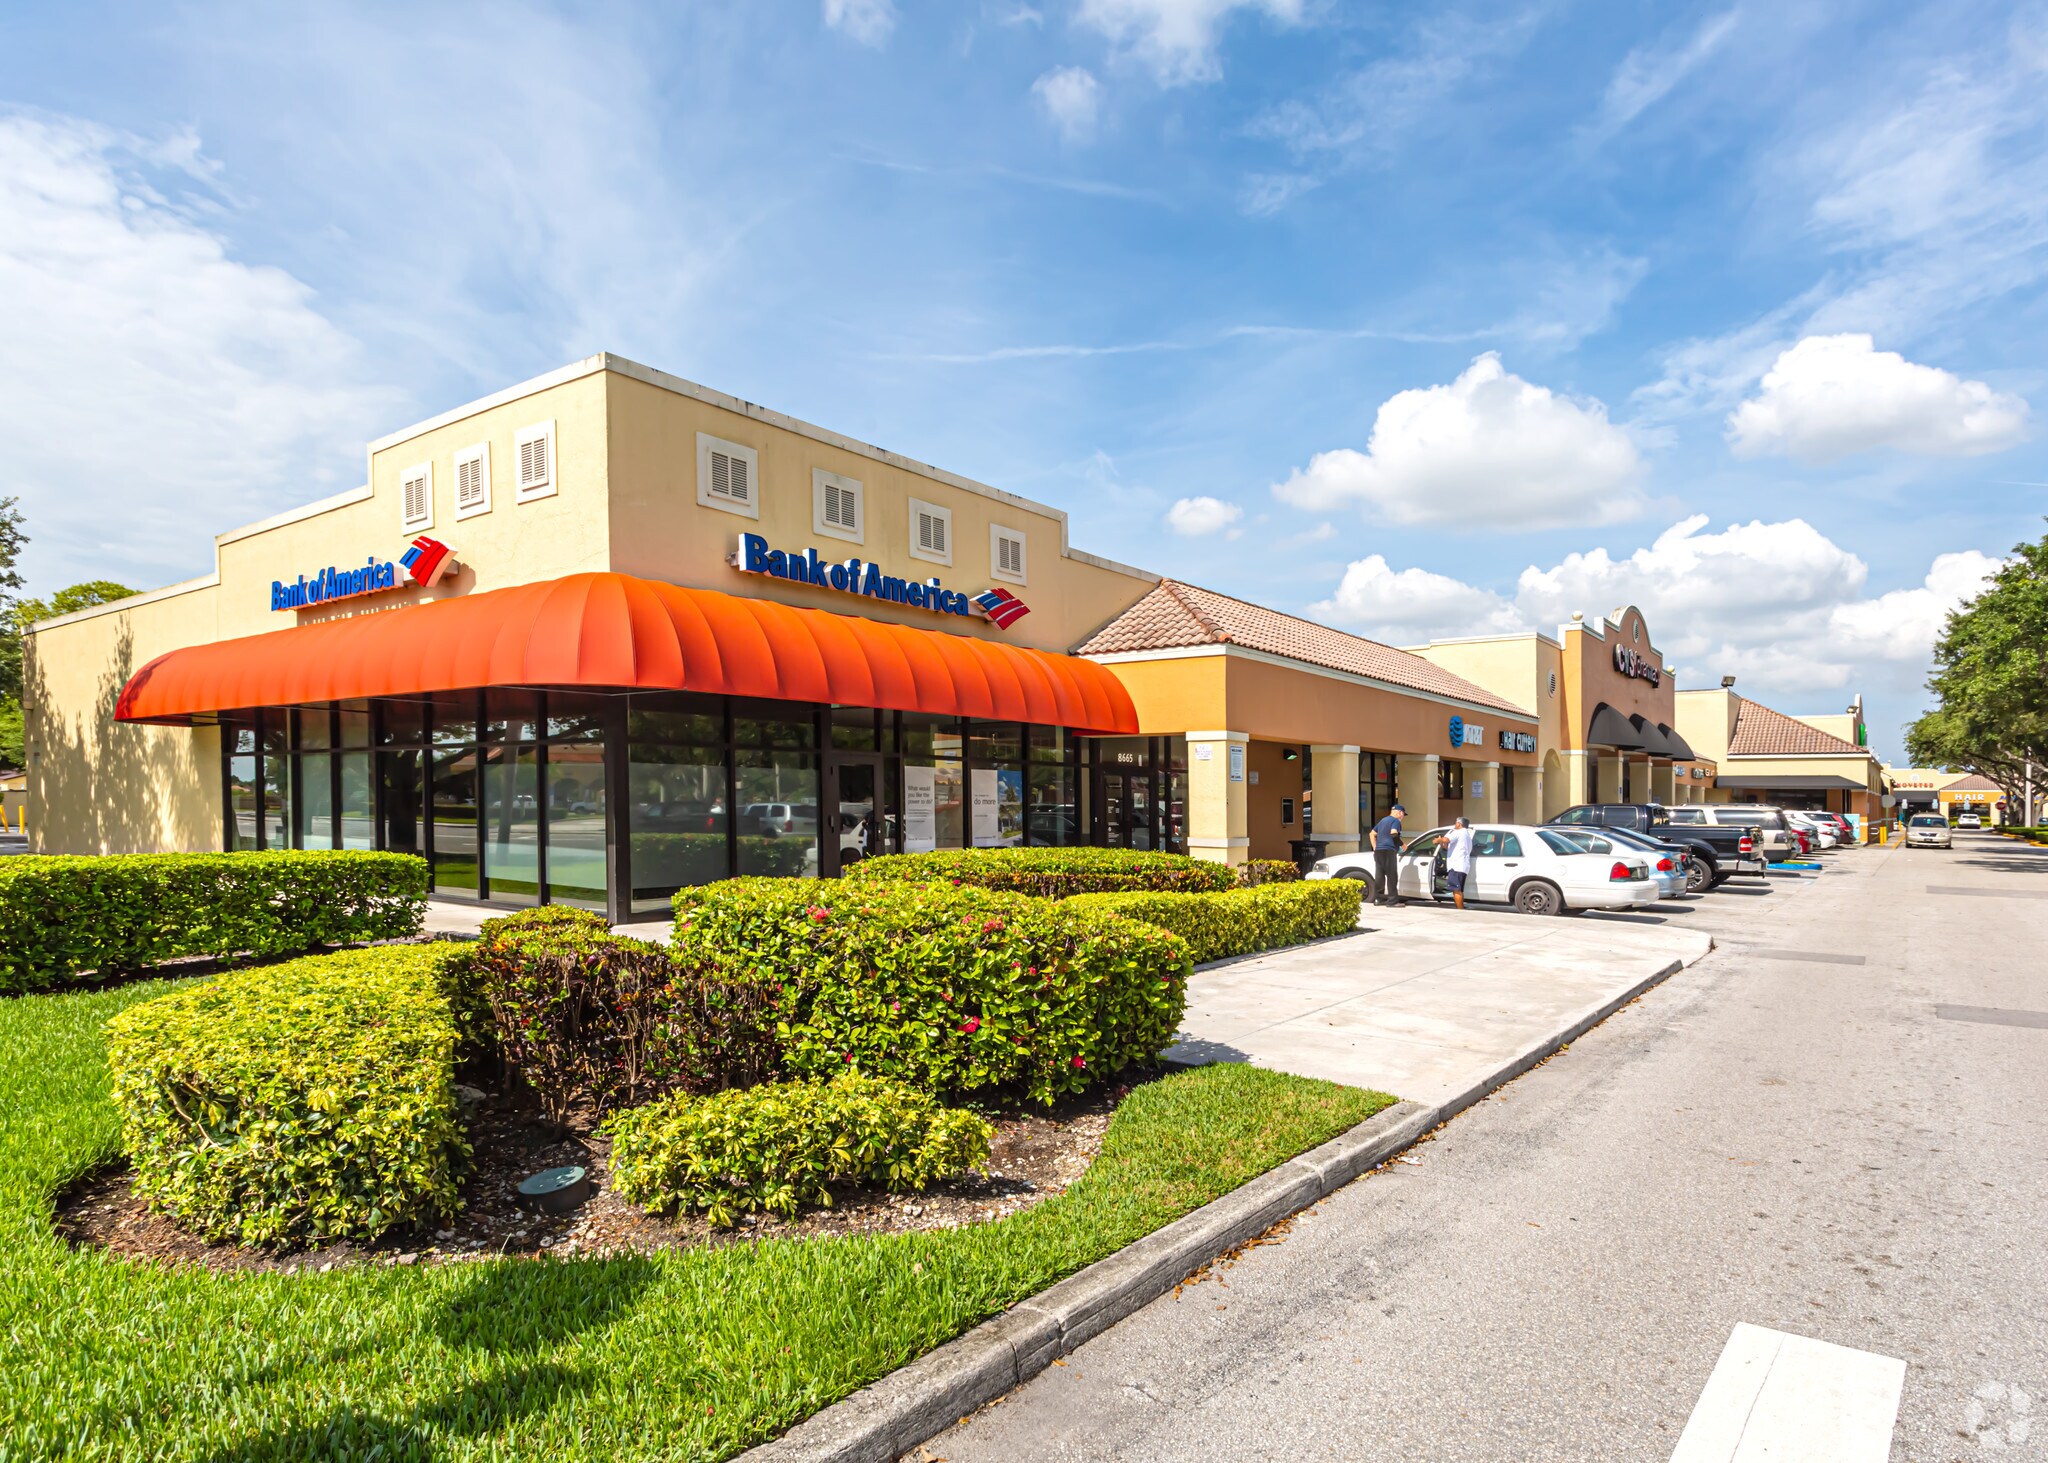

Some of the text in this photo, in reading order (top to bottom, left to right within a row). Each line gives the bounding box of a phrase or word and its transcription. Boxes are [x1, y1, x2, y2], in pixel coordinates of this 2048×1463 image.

[271, 556, 395, 611] Bank of America
[741, 532, 969, 616] Bank of America
[1117, 753, 1133, 763] 8665
[1954, 794, 1985, 802] HAIR
